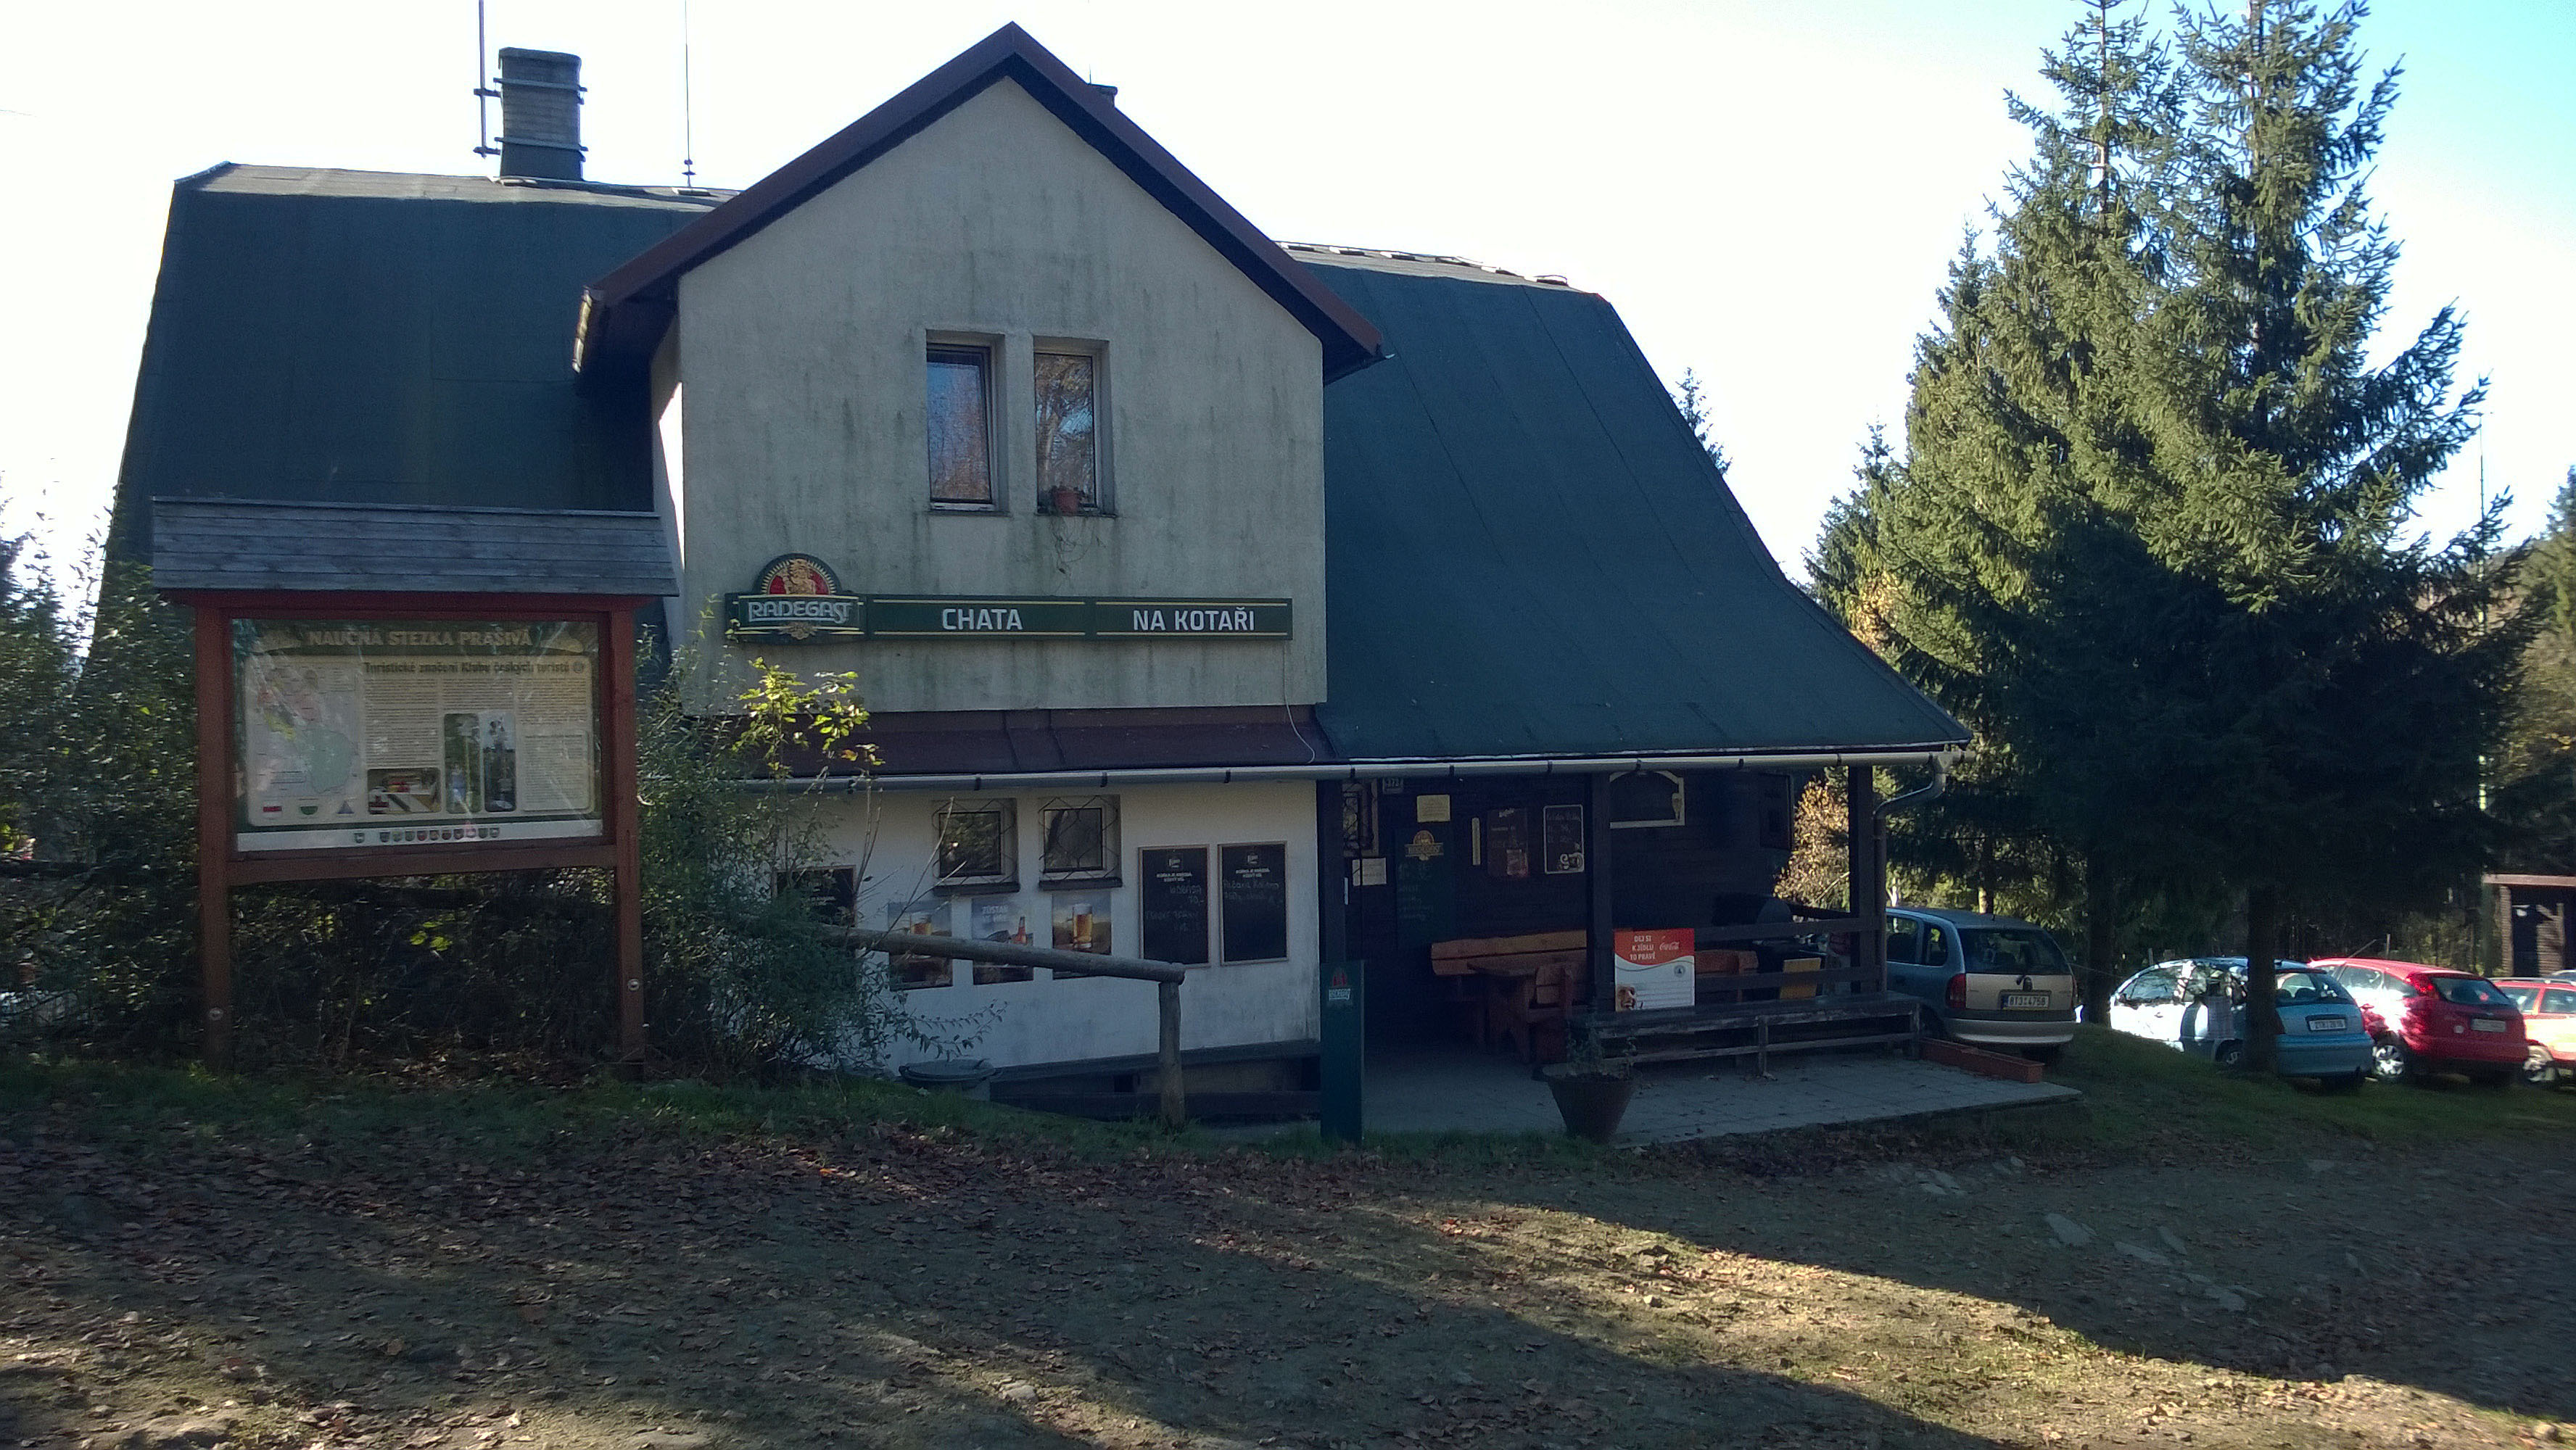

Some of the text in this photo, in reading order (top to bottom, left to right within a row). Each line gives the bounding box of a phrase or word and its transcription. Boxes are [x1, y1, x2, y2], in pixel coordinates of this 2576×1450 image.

[748, 600, 851, 624] RADEGAST
[942, 606, 1255, 631] CHATA NA KOTAŘI
[388, 631, 454, 645] STEZKA
